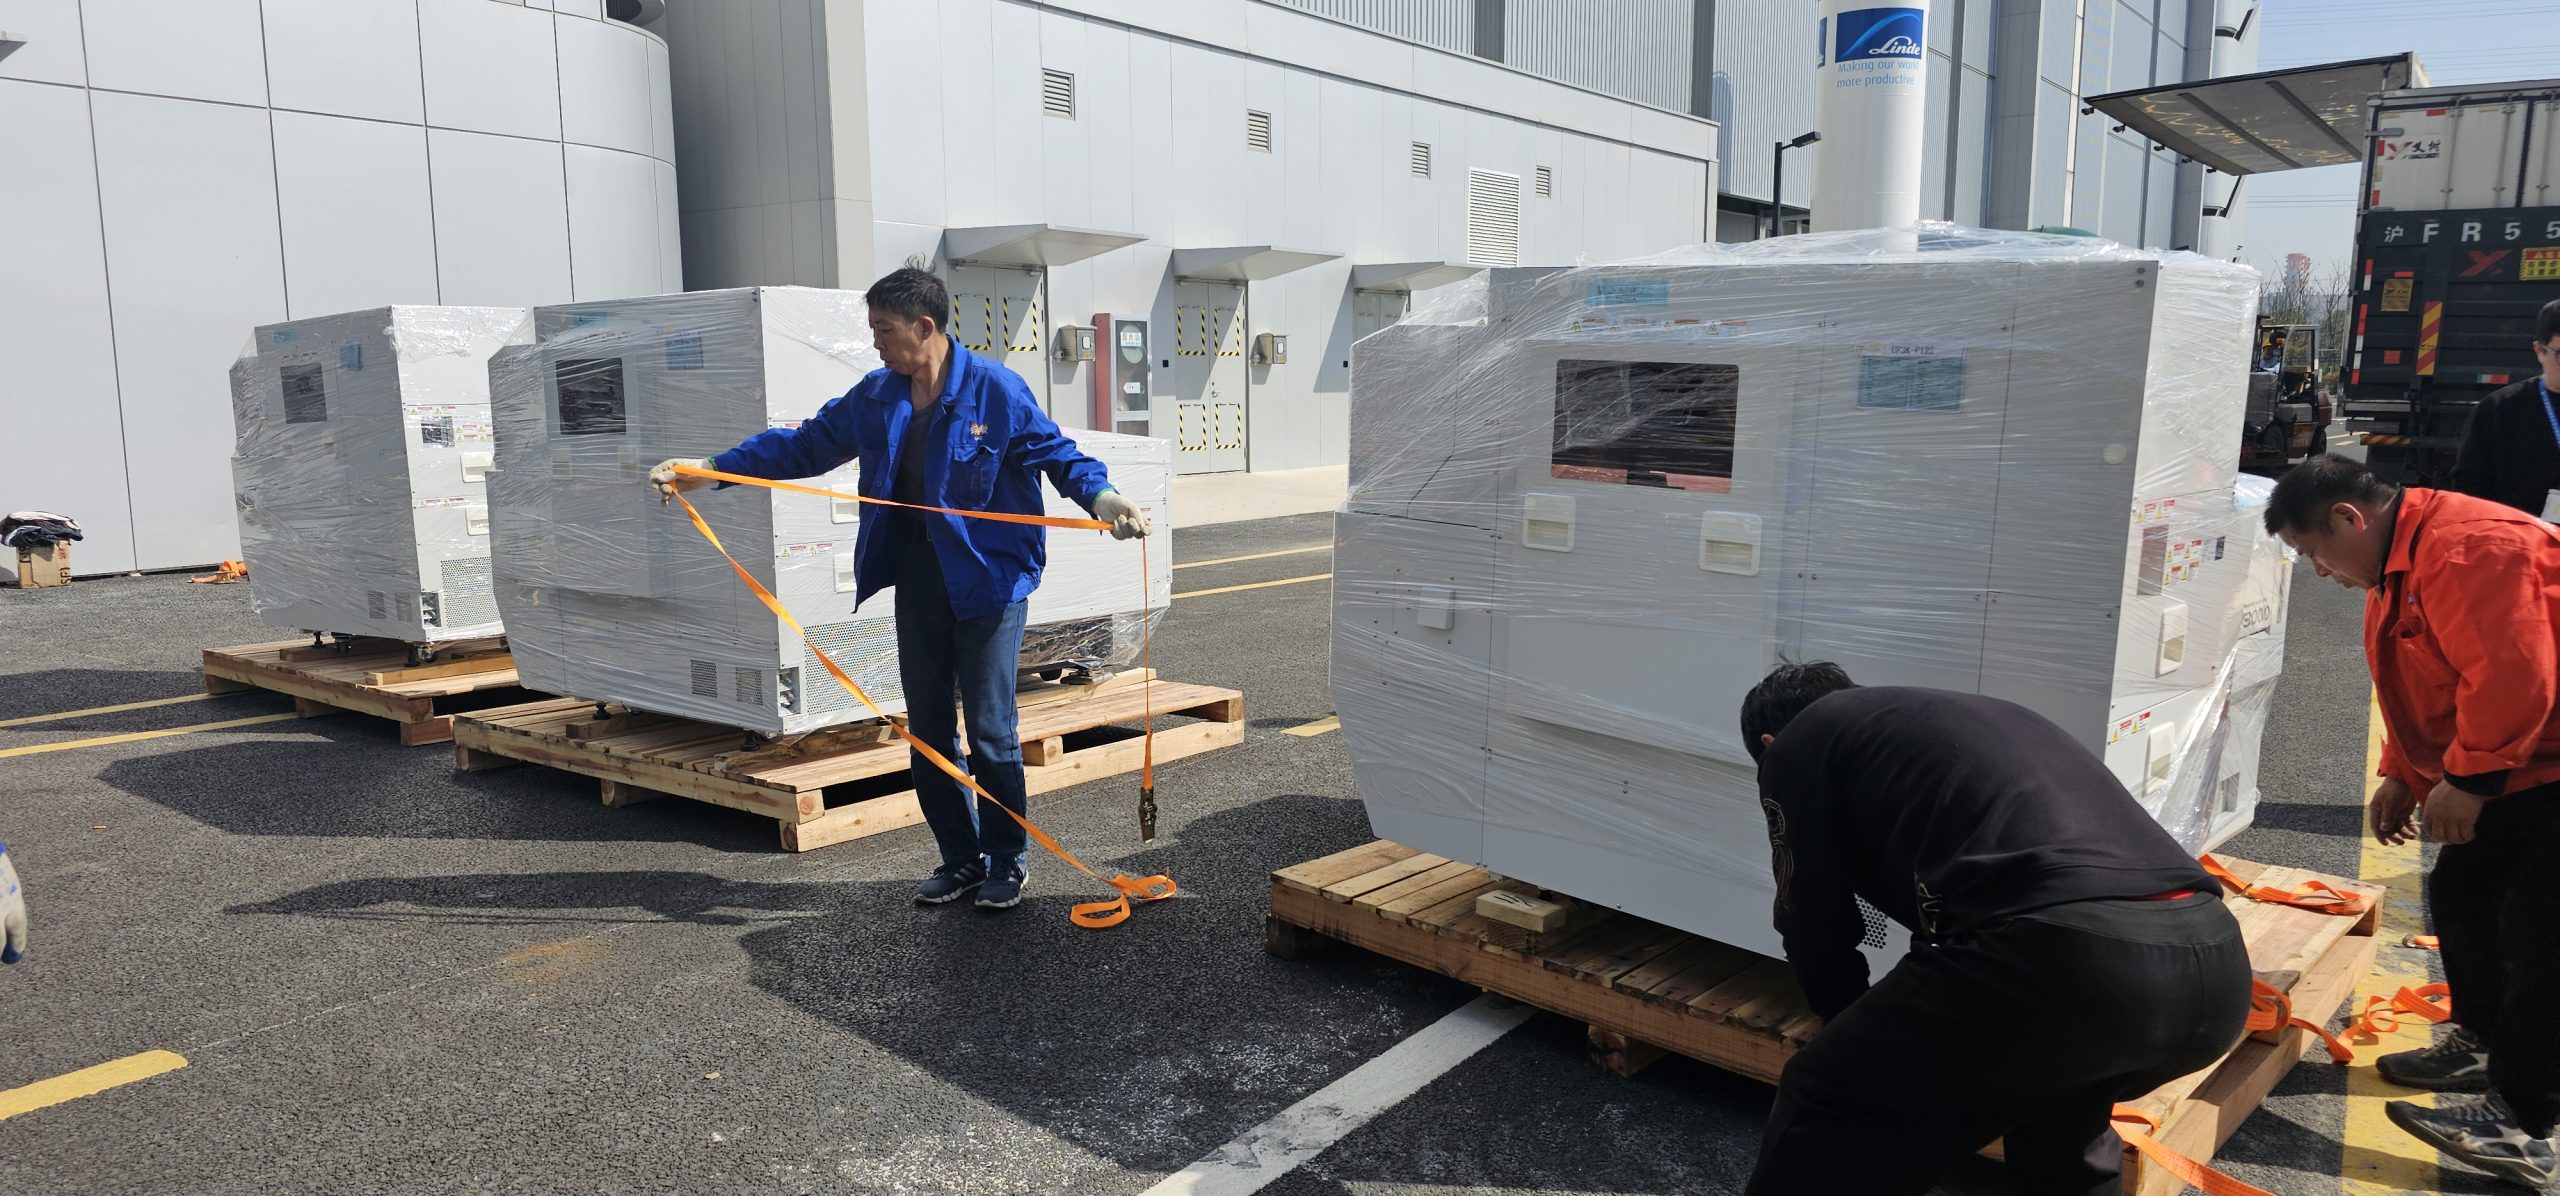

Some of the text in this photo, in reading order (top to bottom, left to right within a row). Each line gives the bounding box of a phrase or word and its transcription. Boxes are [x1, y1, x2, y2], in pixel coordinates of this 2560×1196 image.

[1869, 35, 1921, 55] Linde
[1838, 60, 1920, 73] Making our world
[1836, 74, 1916, 88] more productive
